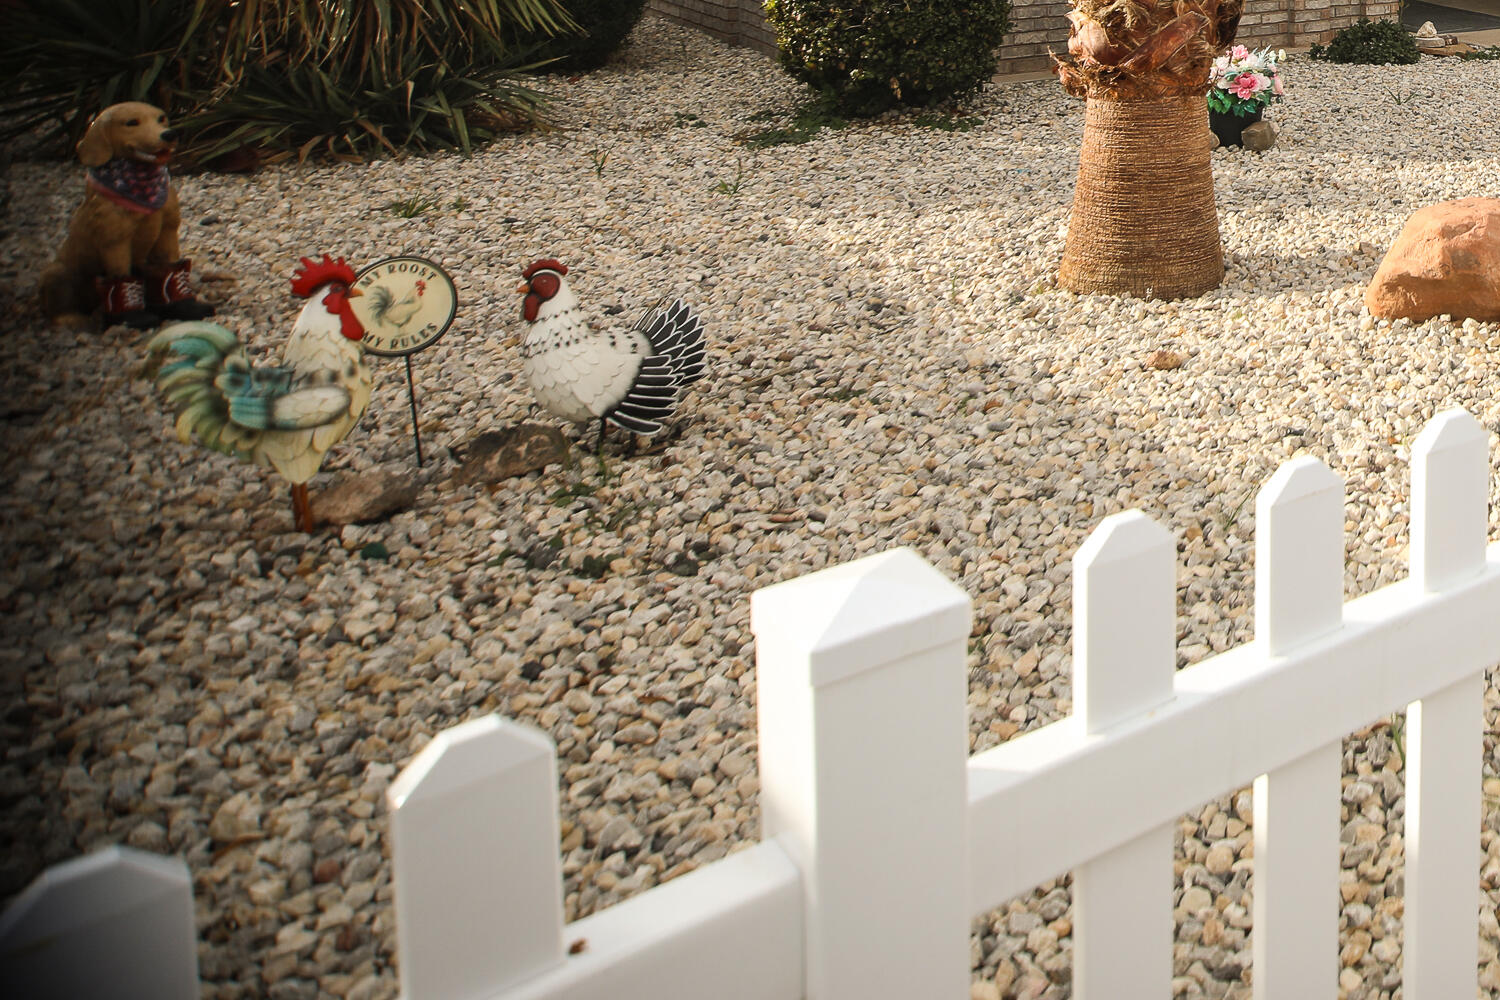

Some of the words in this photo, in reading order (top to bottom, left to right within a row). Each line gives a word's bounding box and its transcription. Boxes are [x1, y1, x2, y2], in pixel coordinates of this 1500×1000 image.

[361, 272, 380, 286] MY
[388, 263, 436, 281] ROOST
[364, 330, 385, 348] MY
[391, 323, 437, 349] RULES
